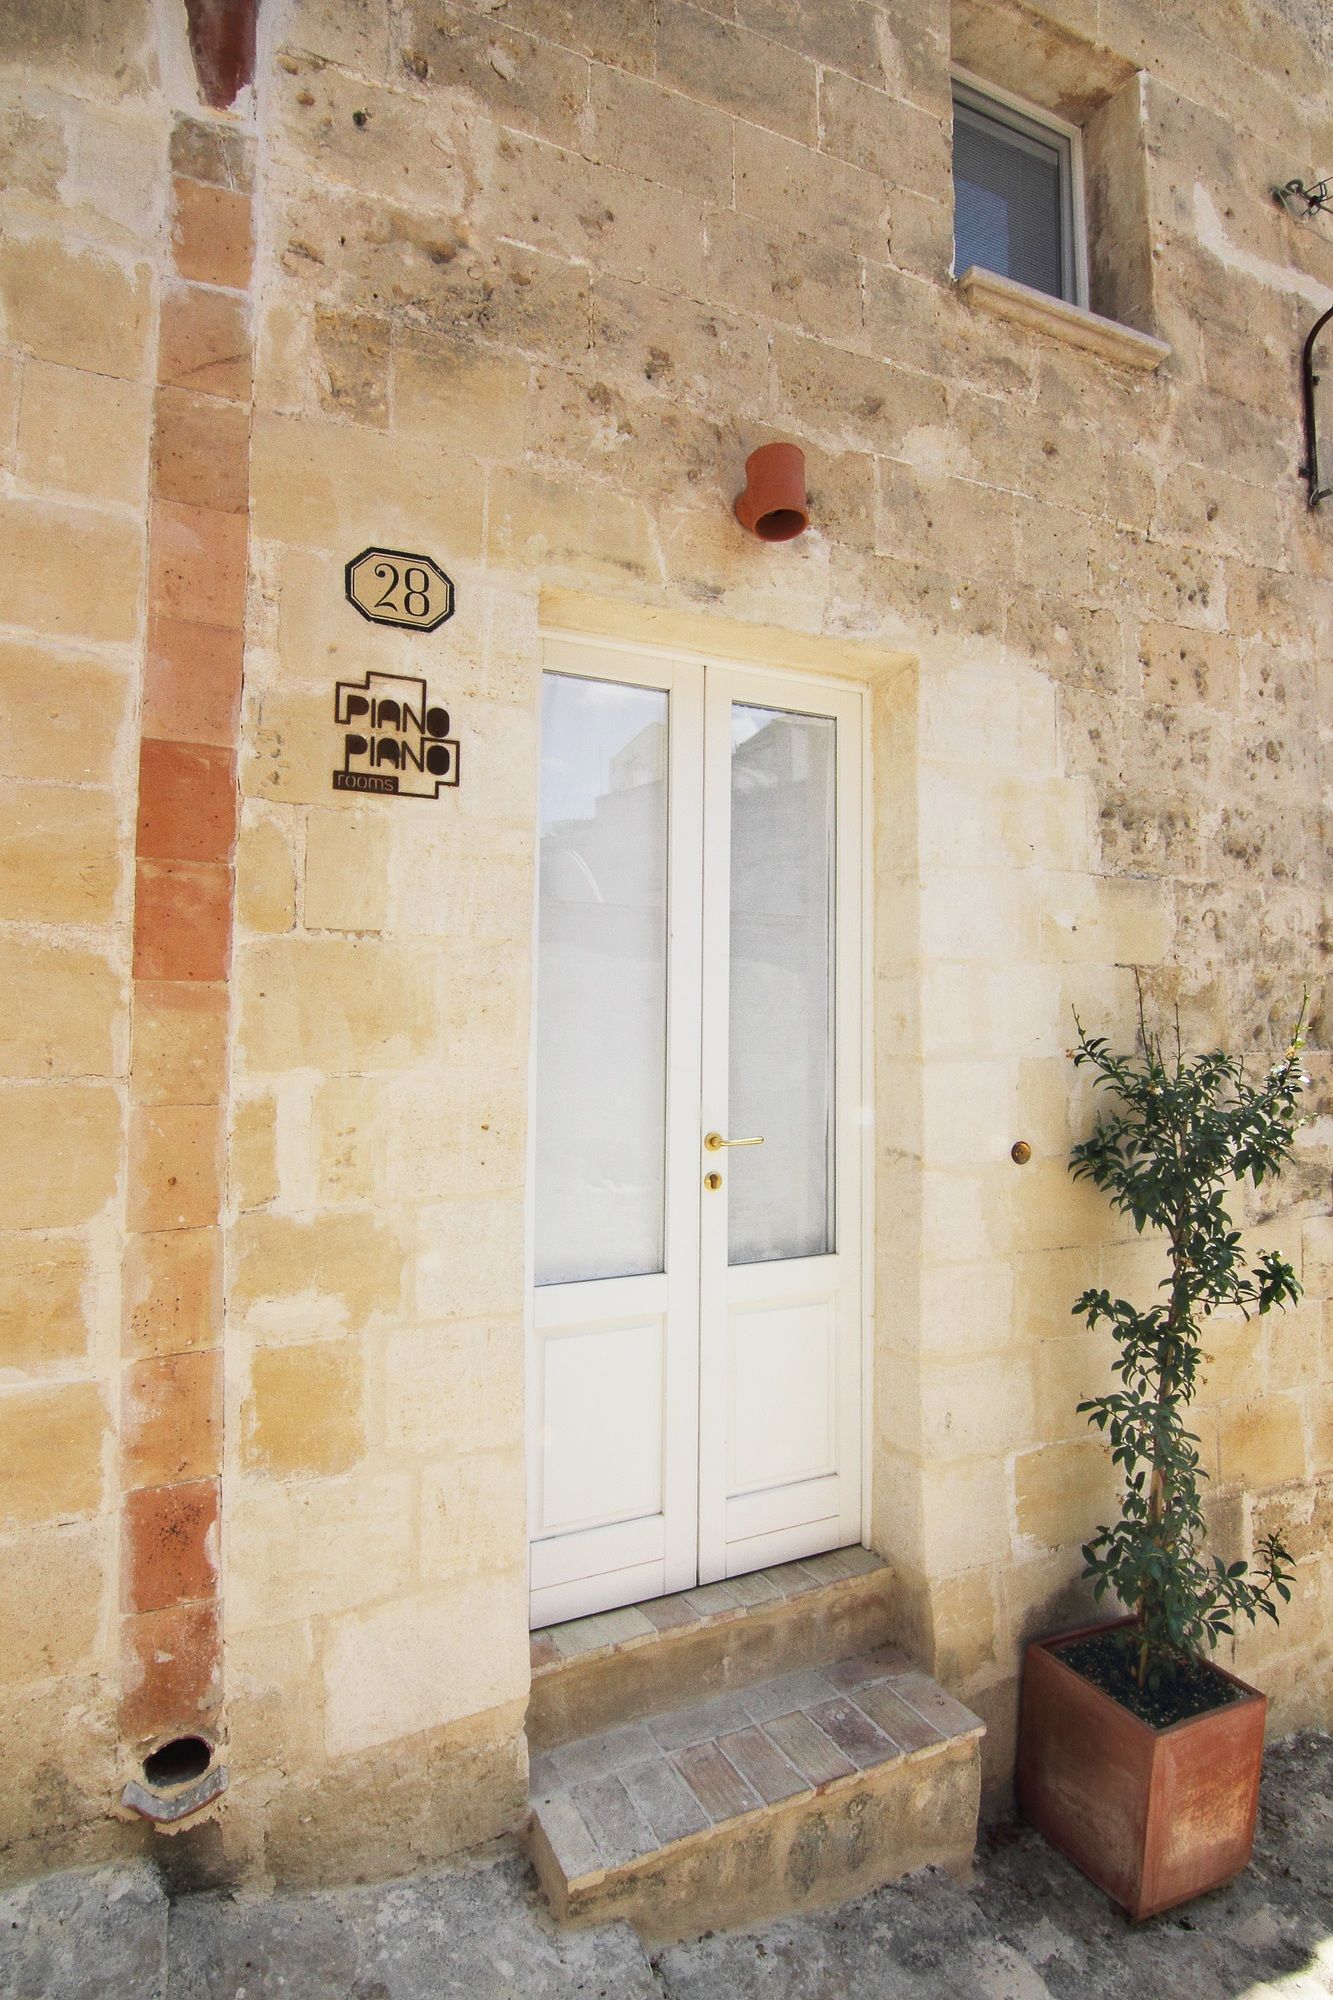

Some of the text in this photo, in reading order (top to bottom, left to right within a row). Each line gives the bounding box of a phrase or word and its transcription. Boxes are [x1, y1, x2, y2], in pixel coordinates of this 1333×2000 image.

[374, 563, 430, 617] 28
[347, 694, 450, 738] PIANO
[345, 733, 450, 776] PIANO
[337, 774, 394, 792] rooms
